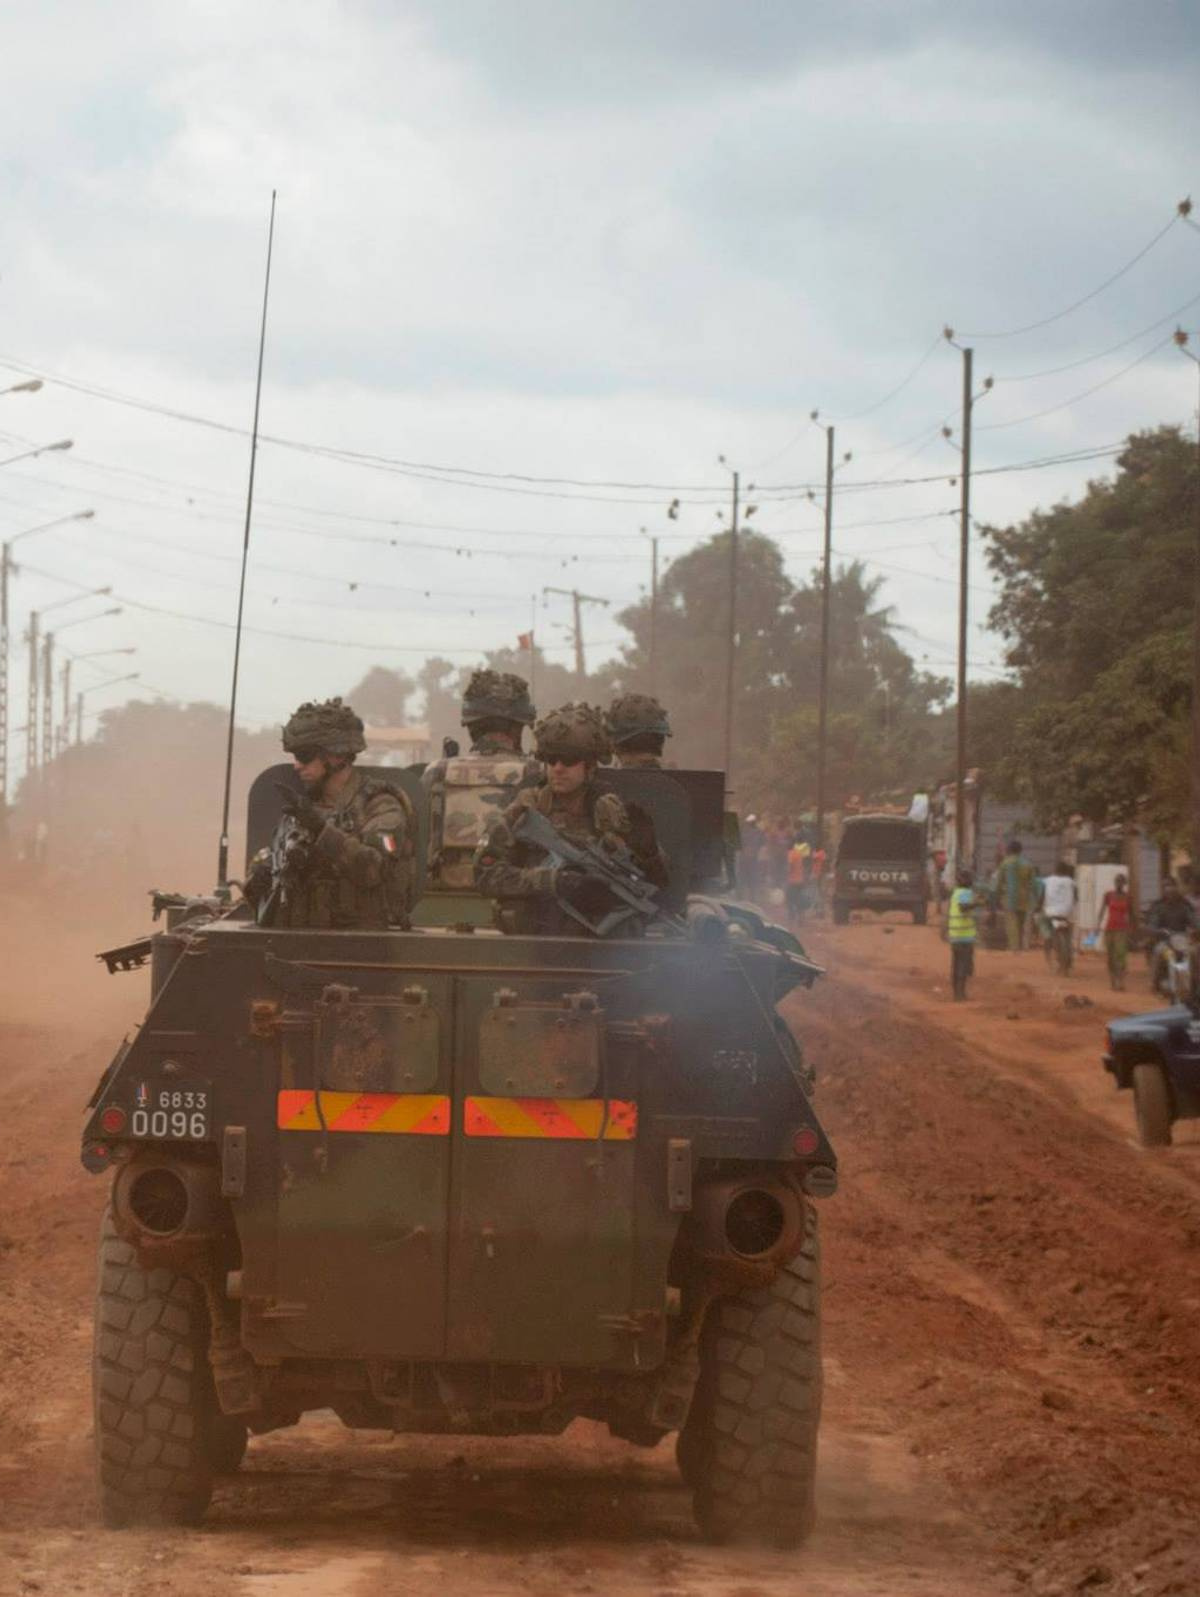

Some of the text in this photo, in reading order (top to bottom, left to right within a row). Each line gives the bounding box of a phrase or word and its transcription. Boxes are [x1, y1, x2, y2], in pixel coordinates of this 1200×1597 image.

[850, 869, 909, 882] TOYOTA
[159, 1091, 207, 1109] 6833
[132, 1110, 206, 1138] 0096
